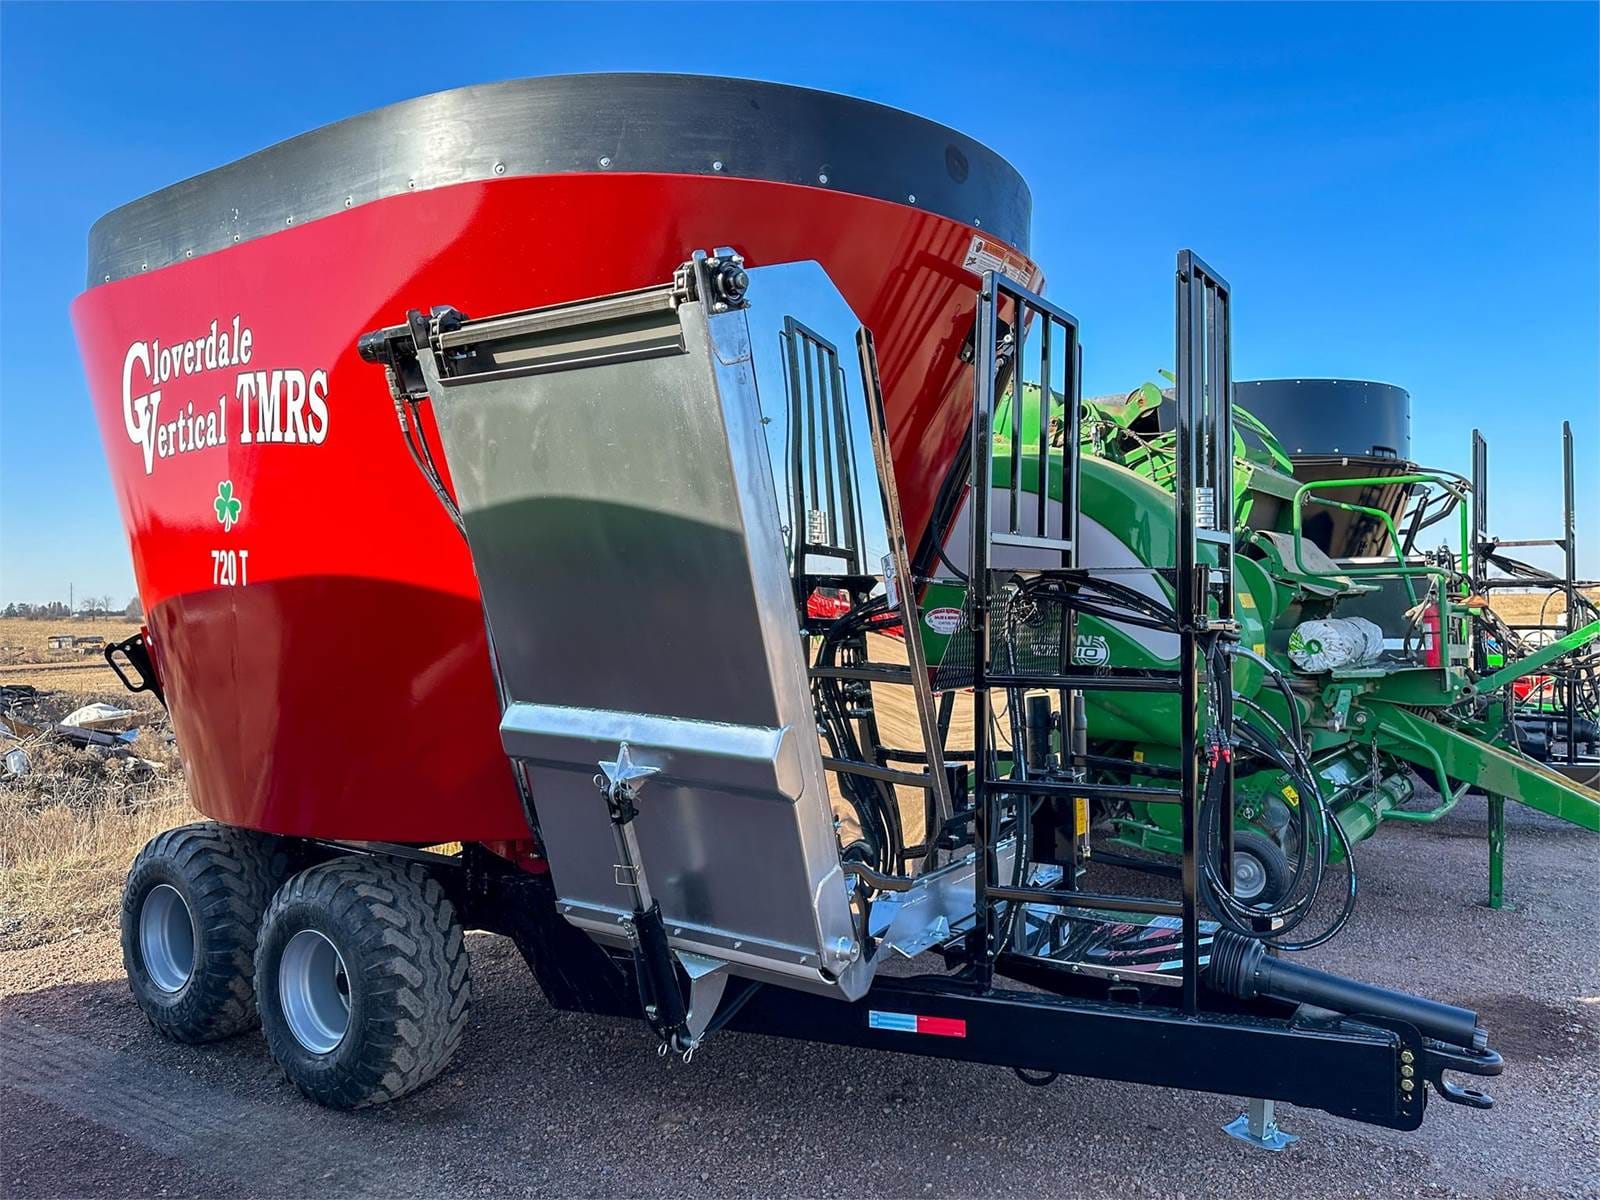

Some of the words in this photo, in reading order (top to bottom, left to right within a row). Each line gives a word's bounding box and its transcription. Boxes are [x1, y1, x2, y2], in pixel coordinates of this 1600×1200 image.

[122, 313, 253, 445] Cloverdale
[133, 388, 227, 477] Vertical
[235, 367, 329, 446] TMRS
[211, 549, 237, 587] 720
[239, 549, 249, 587] T
